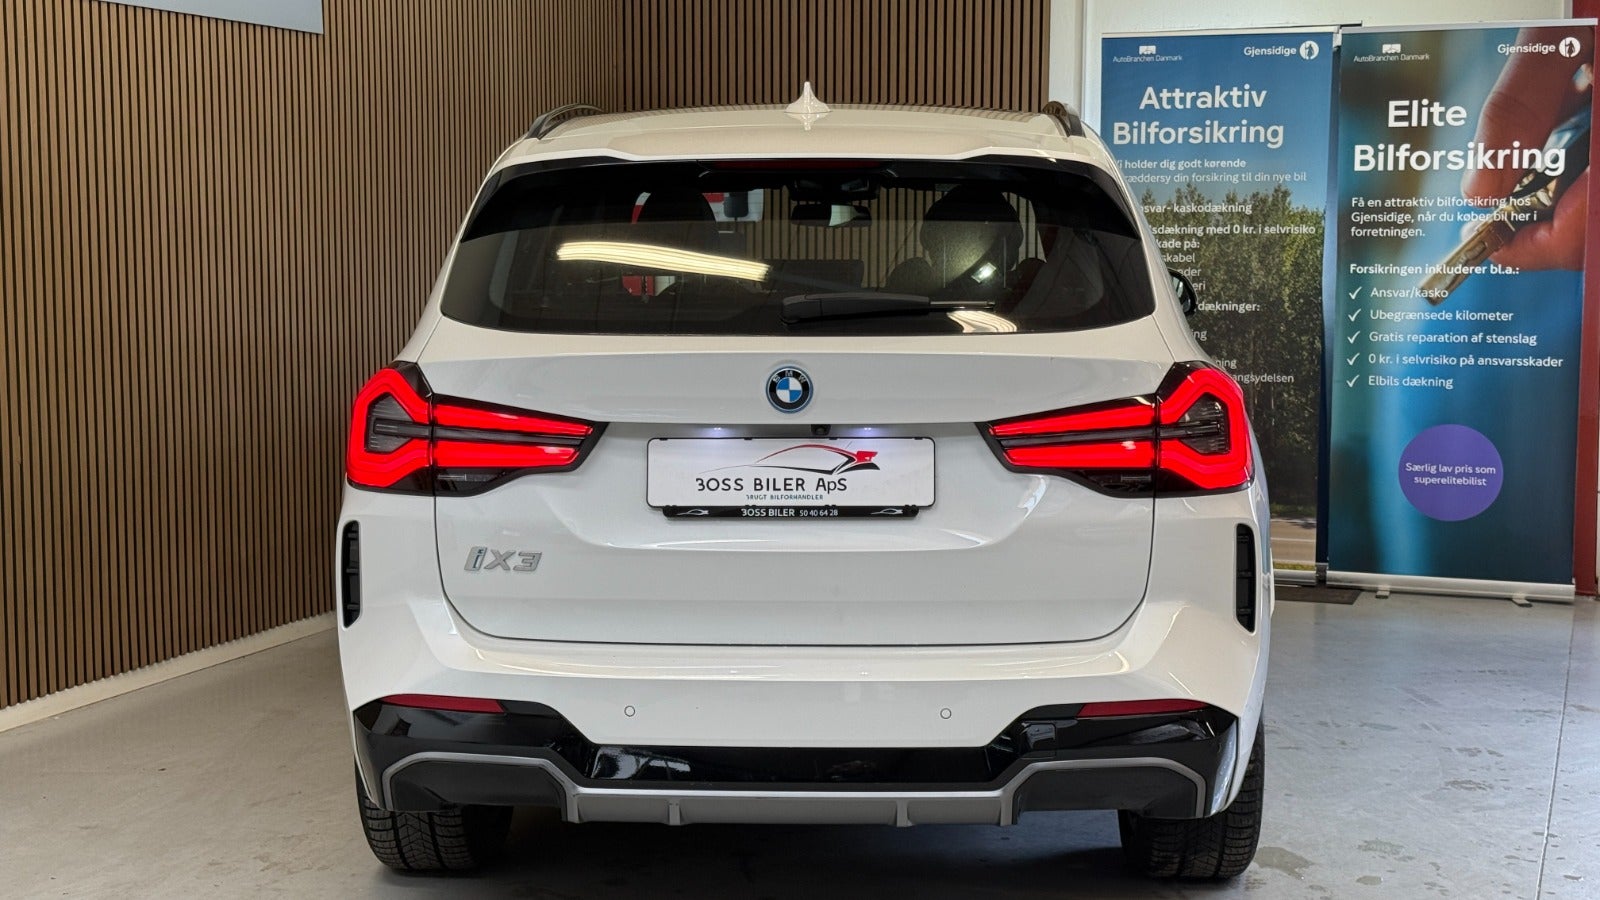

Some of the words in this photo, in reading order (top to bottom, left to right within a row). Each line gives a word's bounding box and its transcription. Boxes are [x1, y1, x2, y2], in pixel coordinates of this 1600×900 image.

[1243, 46, 1297, 56] Gjensidige
[1497, 43, 1556, 55] Gjensidige
[1112, 54, 1154, 63] AutoBranchen
[1155, 53, 1183, 62] Danmark
[1353, 54, 1399, 63] AutoBranchen
[1400, 53, 1430, 61] Danmark
[1139, 83, 1267, 110] Attraktiv
[1388, 98, 1467, 128] Elite
[1113, 119, 1284, 149] Bilforsikring
[1125, 159, 1158, 169] holder
[1160, 159, 1176, 171] dig
[1178, 159, 1202, 171] godt
[1204, 158, 1247, 169] kørende
[1354, 140, 1566, 177] Bilforsikring
[1124, 173, 1171, 184] ræddersy
[1173, 172, 1189, 182] din
[1191, 171, 1239, 183] forsikring
[1241, 171, 1252, 181] til
[1254, 171, 1270, 181] din
[1272, 173, 1291, 183] nye
[1293, 170, 1307, 181] bil
[1351, 197, 1365, 207] Få
[1384, 198, 1434, 207] attraktiv
[1436, 196, 1507, 208] bilforsikring
[1509, 196, 1531, 206] hos
[1141, 204, 1171, 213] svar-
[1173, 202, 1252, 215] kaskodækning
[1351, 212, 1415, 223] Gjensidige,
[1417, 211, 1436, 222] når
[1439, 212, 1454, 221] du
[1456, 211, 1492, 221] køber
[1493, 211, 1508, 221] bil
[1510, 211, 1531, 221] her
[1533, 211, 1537, 221] i
[1206, 224, 1231, 234] med
[1233, 224, 1241, 234] 0
[1243, 224, 1257, 234] kr.
[1264, 223, 1316, 234] selvrisiko
[1350, 226, 1426, 238] forretningen.
[1156, 239, 1182, 248] kade
[1184, 240, 1200, 250] på:
[1350, 264, 1423, 275] Forsikringen
[1425, 263, 1487, 275] inkluderer
[1490, 264, 1520, 275] bl.a.:
[1370, 287, 1449, 299] Ansvar/kasko
[1370, 309, 1453, 322] Ubegrænsede
[1455, 310, 1514, 321] kilometer
[1369, 332, 1404, 343] Gratis
[1406, 332, 1468, 345] reparation
[1471, 332, 1483, 343] af
[1485, 333, 1537, 346] stenslag
[1368, 354, 1376, 364] 0
[1379, 354, 1394, 364] kr.
[1402, 355, 1457, 365] selvrisiko
[1459, 356, 1474, 368] på
[1477, 356, 1563, 367] ansvarsskader
[1233, 374, 1294, 384] angsydelsen
[1368, 376, 1400, 386] Elbils
[1402, 376, 1453, 389] dækning
[1405, 462, 1437, 474] Særlig
[1439, 464, 1452, 473] lav
[1455, 464, 1473, 474] pris
[754, 478, 805, 491] BILER
[815, 478, 847, 494] ApS
[1414, 476, 1487, 486] superelitebilist
[768, 508, 795, 516] BILER
[464, 546, 542, 571] iX3
